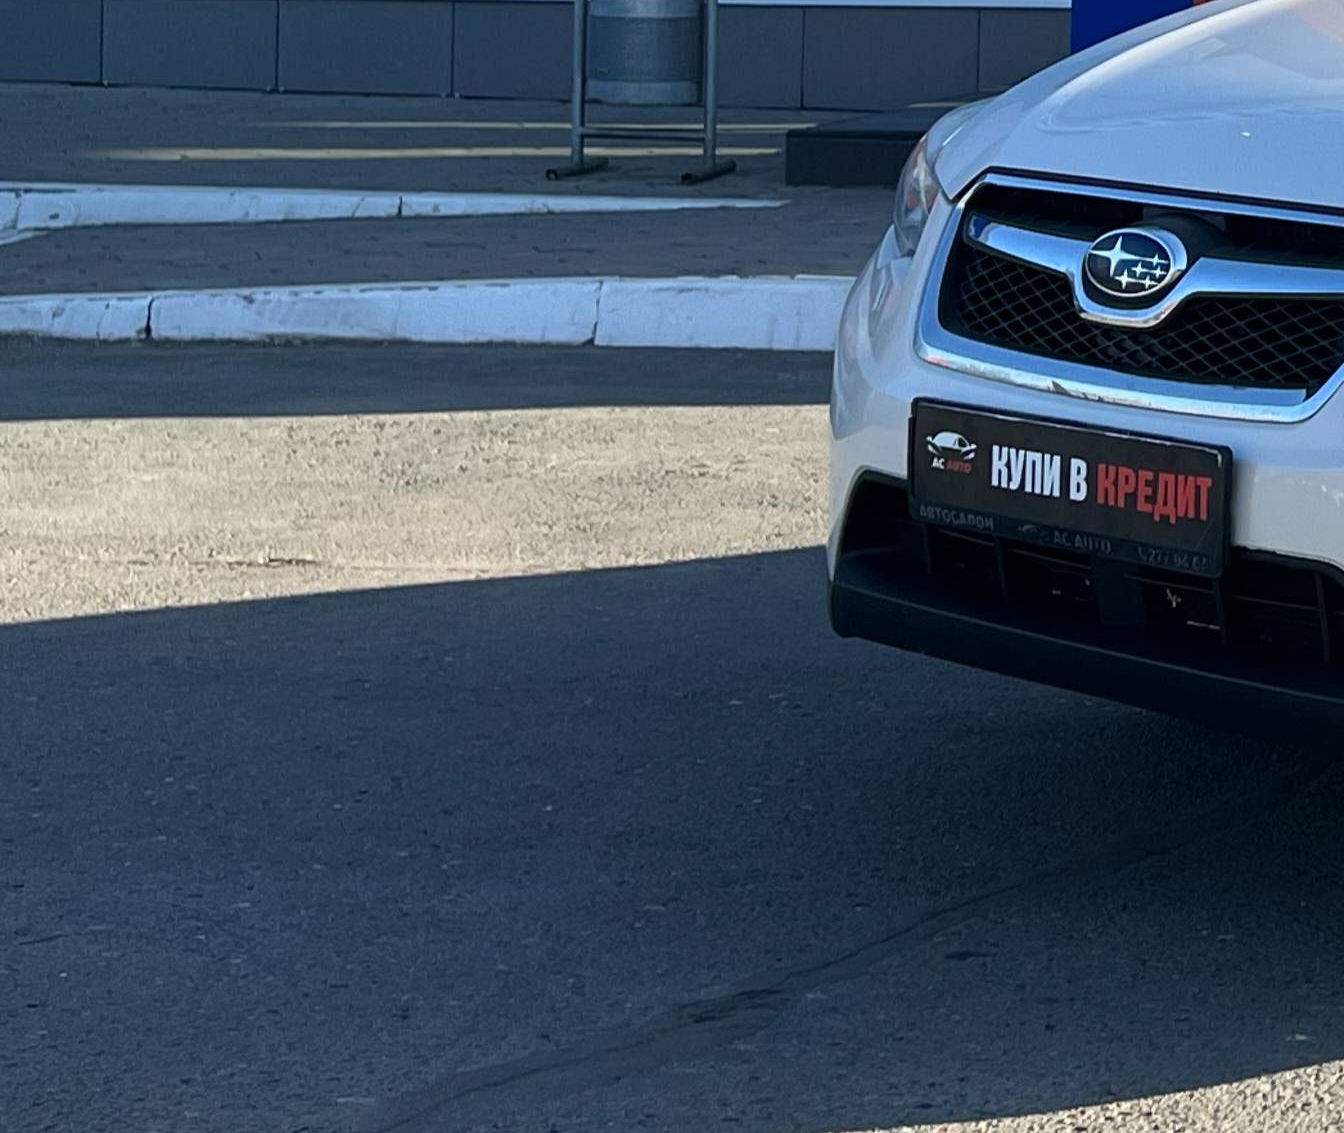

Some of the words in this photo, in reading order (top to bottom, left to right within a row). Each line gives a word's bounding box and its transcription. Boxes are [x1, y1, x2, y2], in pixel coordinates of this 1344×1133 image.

[945, 460, 972, 474] AUTO
[991, 444, 1062, 499] КУПИ
[1069, 458, 1088, 502] В
[1096, 463, 1213, 524] КРЕДИТ
[919, 504, 995, 532] АВТОСАЛОН
